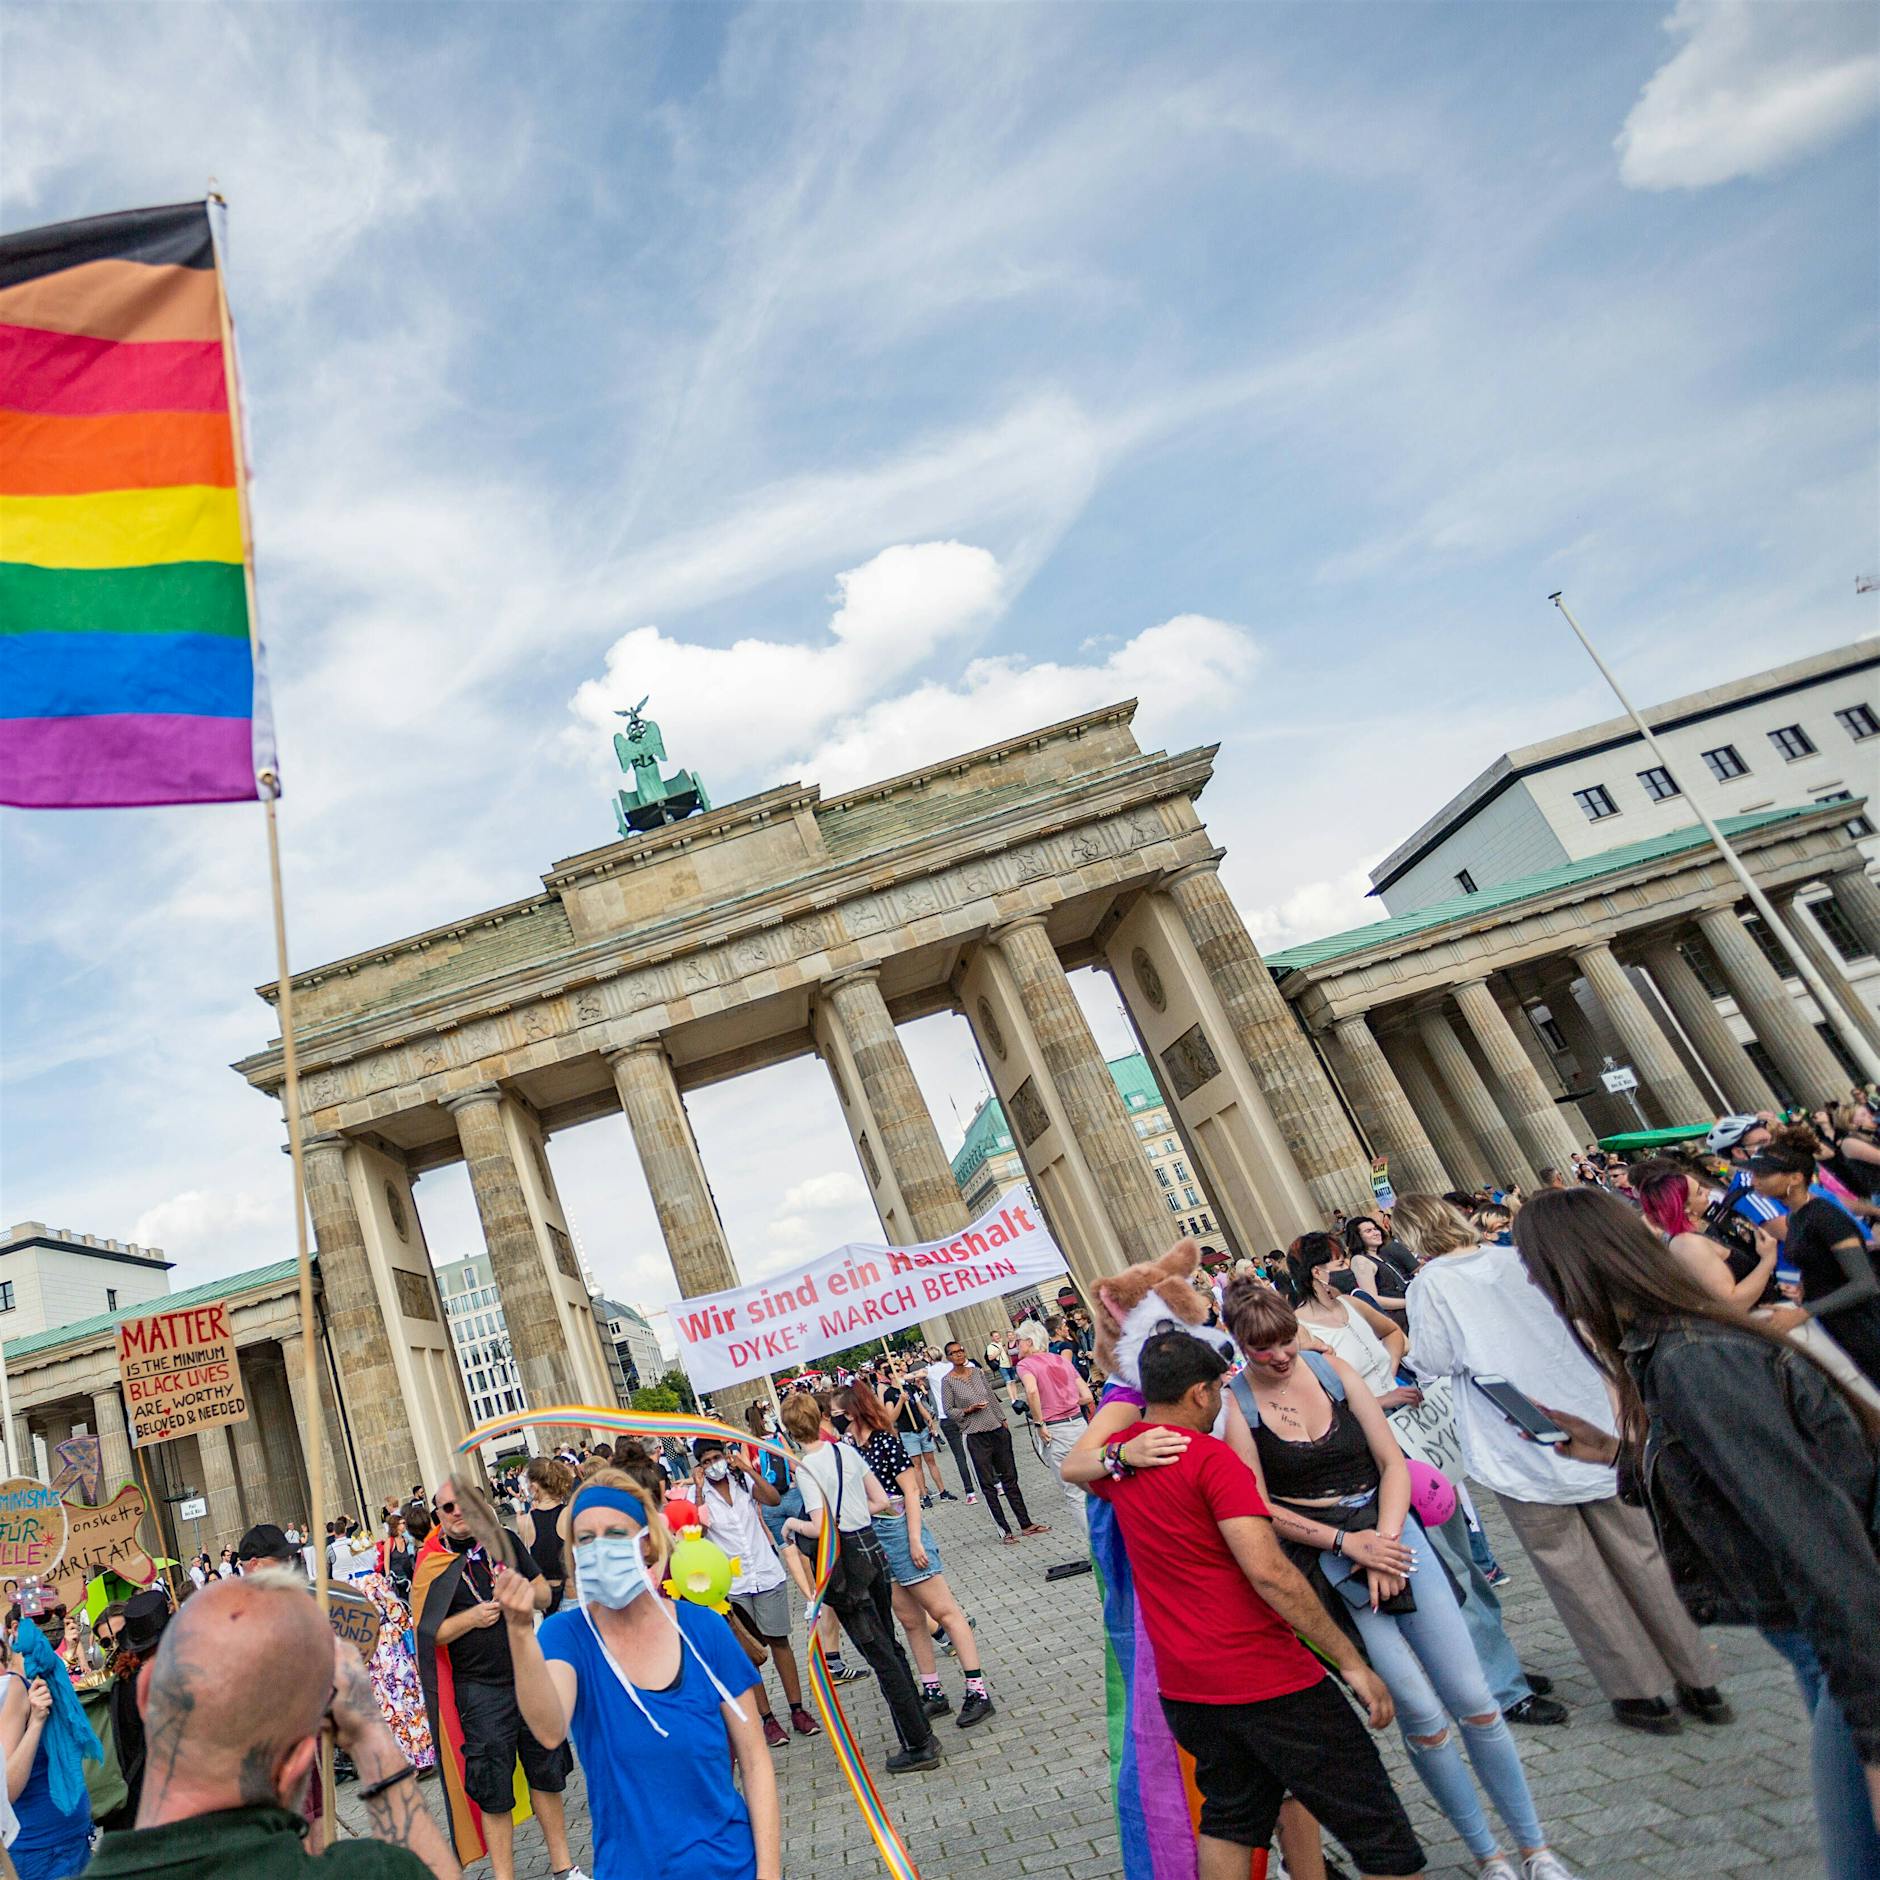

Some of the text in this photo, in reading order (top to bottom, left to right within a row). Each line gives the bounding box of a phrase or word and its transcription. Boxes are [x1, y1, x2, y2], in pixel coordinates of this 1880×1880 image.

[677, 1206, 1036, 1344] Wir sind ein Haushalt
[818, 1285, 917, 1339] MARCH
[921, 1258, 1018, 1304] BERLIN
[127, 1346, 226, 1377] IS THE MINIMUM
[129, 1363, 229, 1401] BLACK LIVES
[173, 1384, 234, 1409] WORTHY
[136, 1398, 245, 1438] BELOVED & NEEDED
